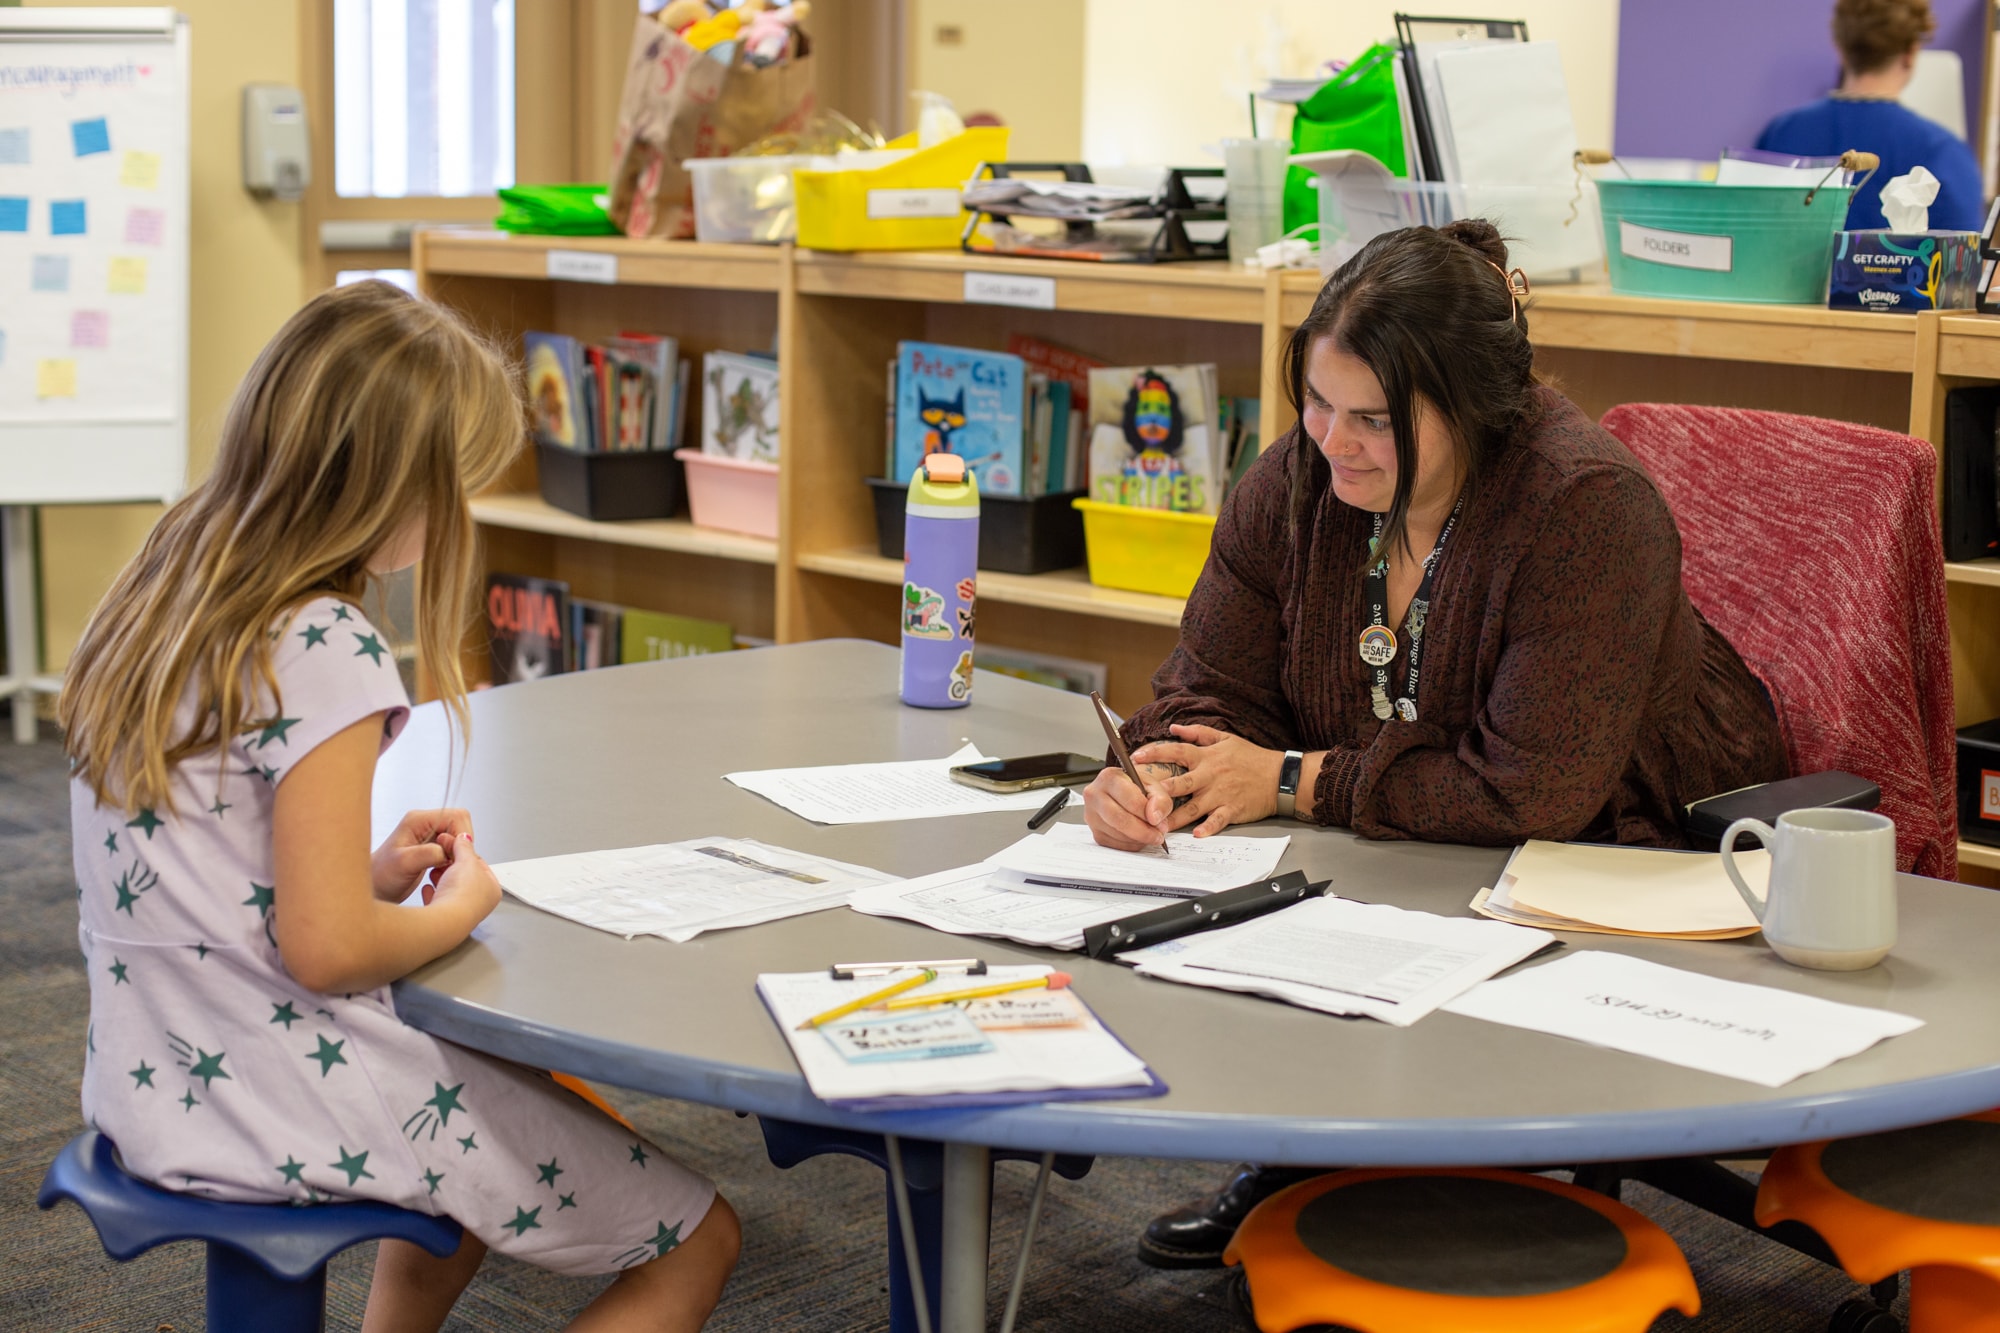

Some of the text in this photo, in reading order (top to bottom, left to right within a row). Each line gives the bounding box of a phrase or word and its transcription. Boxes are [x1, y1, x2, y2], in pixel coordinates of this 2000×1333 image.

[0, 56, 136, 100] ncouragement
[1644, 237, 1690, 256] FOLDERS
[1852, 254, 1914, 266] GET CRAFTY
[1858, 288, 1901, 305] Kleenex
[912, 350, 956, 379] Pete
[972, 360, 1007, 387] Cat
[1096, 474, 1206, 509] STRIPES
[489, 584, 561, 640] OLIVIA
[1370, 603, 1382, 626] ave
[1370, 645, 1391, 658] SAFE
[1410, 638, 1421, 666] onge
[1408, 667, 1419, 695] Blue
